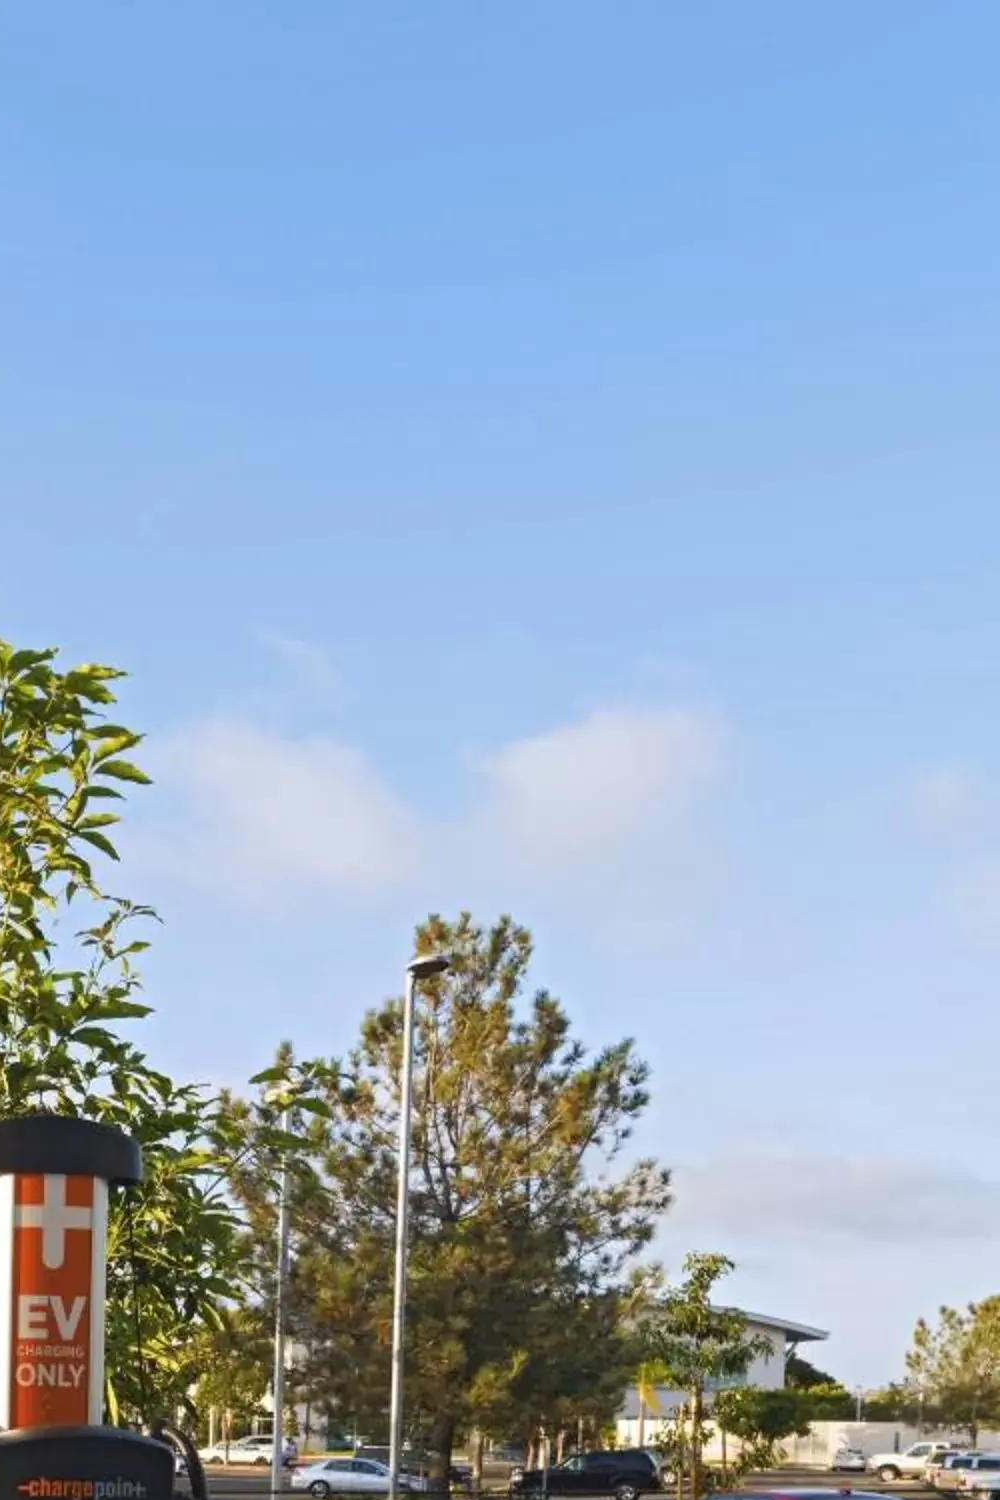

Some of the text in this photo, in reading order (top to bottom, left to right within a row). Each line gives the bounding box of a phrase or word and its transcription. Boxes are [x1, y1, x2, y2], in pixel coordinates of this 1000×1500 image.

[17, 1295, 86, 1341] EV
[16, 1345, 84, 1358] CHARGING
[15, 1362, 85, 1388] ONLY
